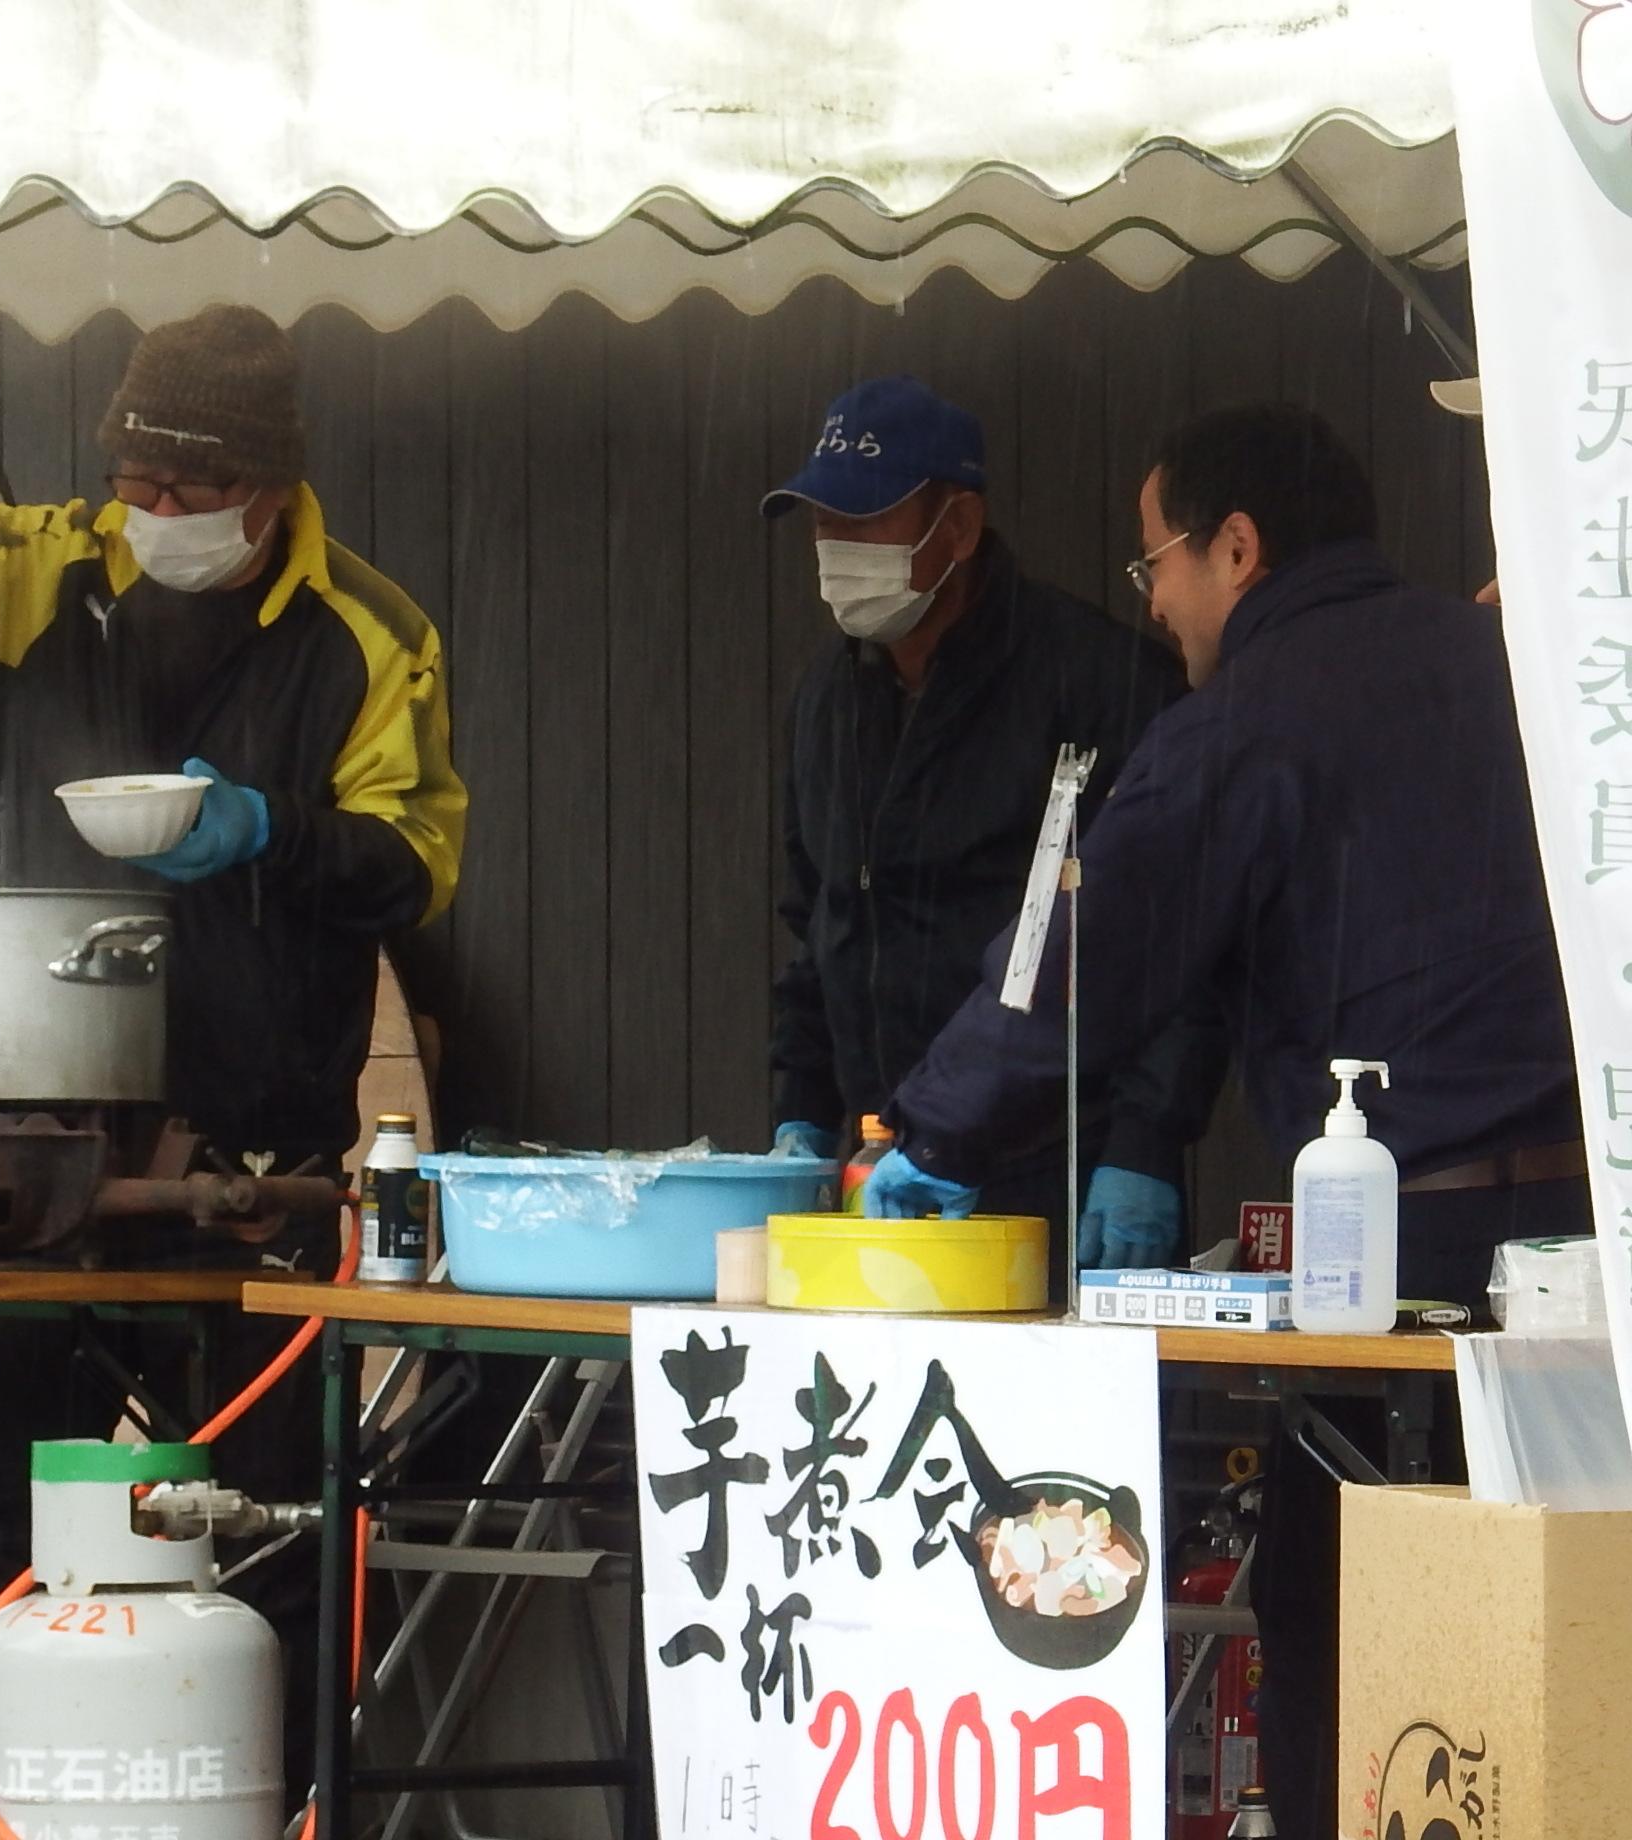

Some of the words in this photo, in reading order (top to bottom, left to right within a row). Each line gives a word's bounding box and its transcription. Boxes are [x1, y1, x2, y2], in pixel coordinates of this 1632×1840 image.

[1248, 1211, 1285, 1265] 消
[648, 1325, 1034, 1600] 芋煮会
[659, 1584, 813, 1723] 一杯
[809, 1687, 1131, 1840] 200円
